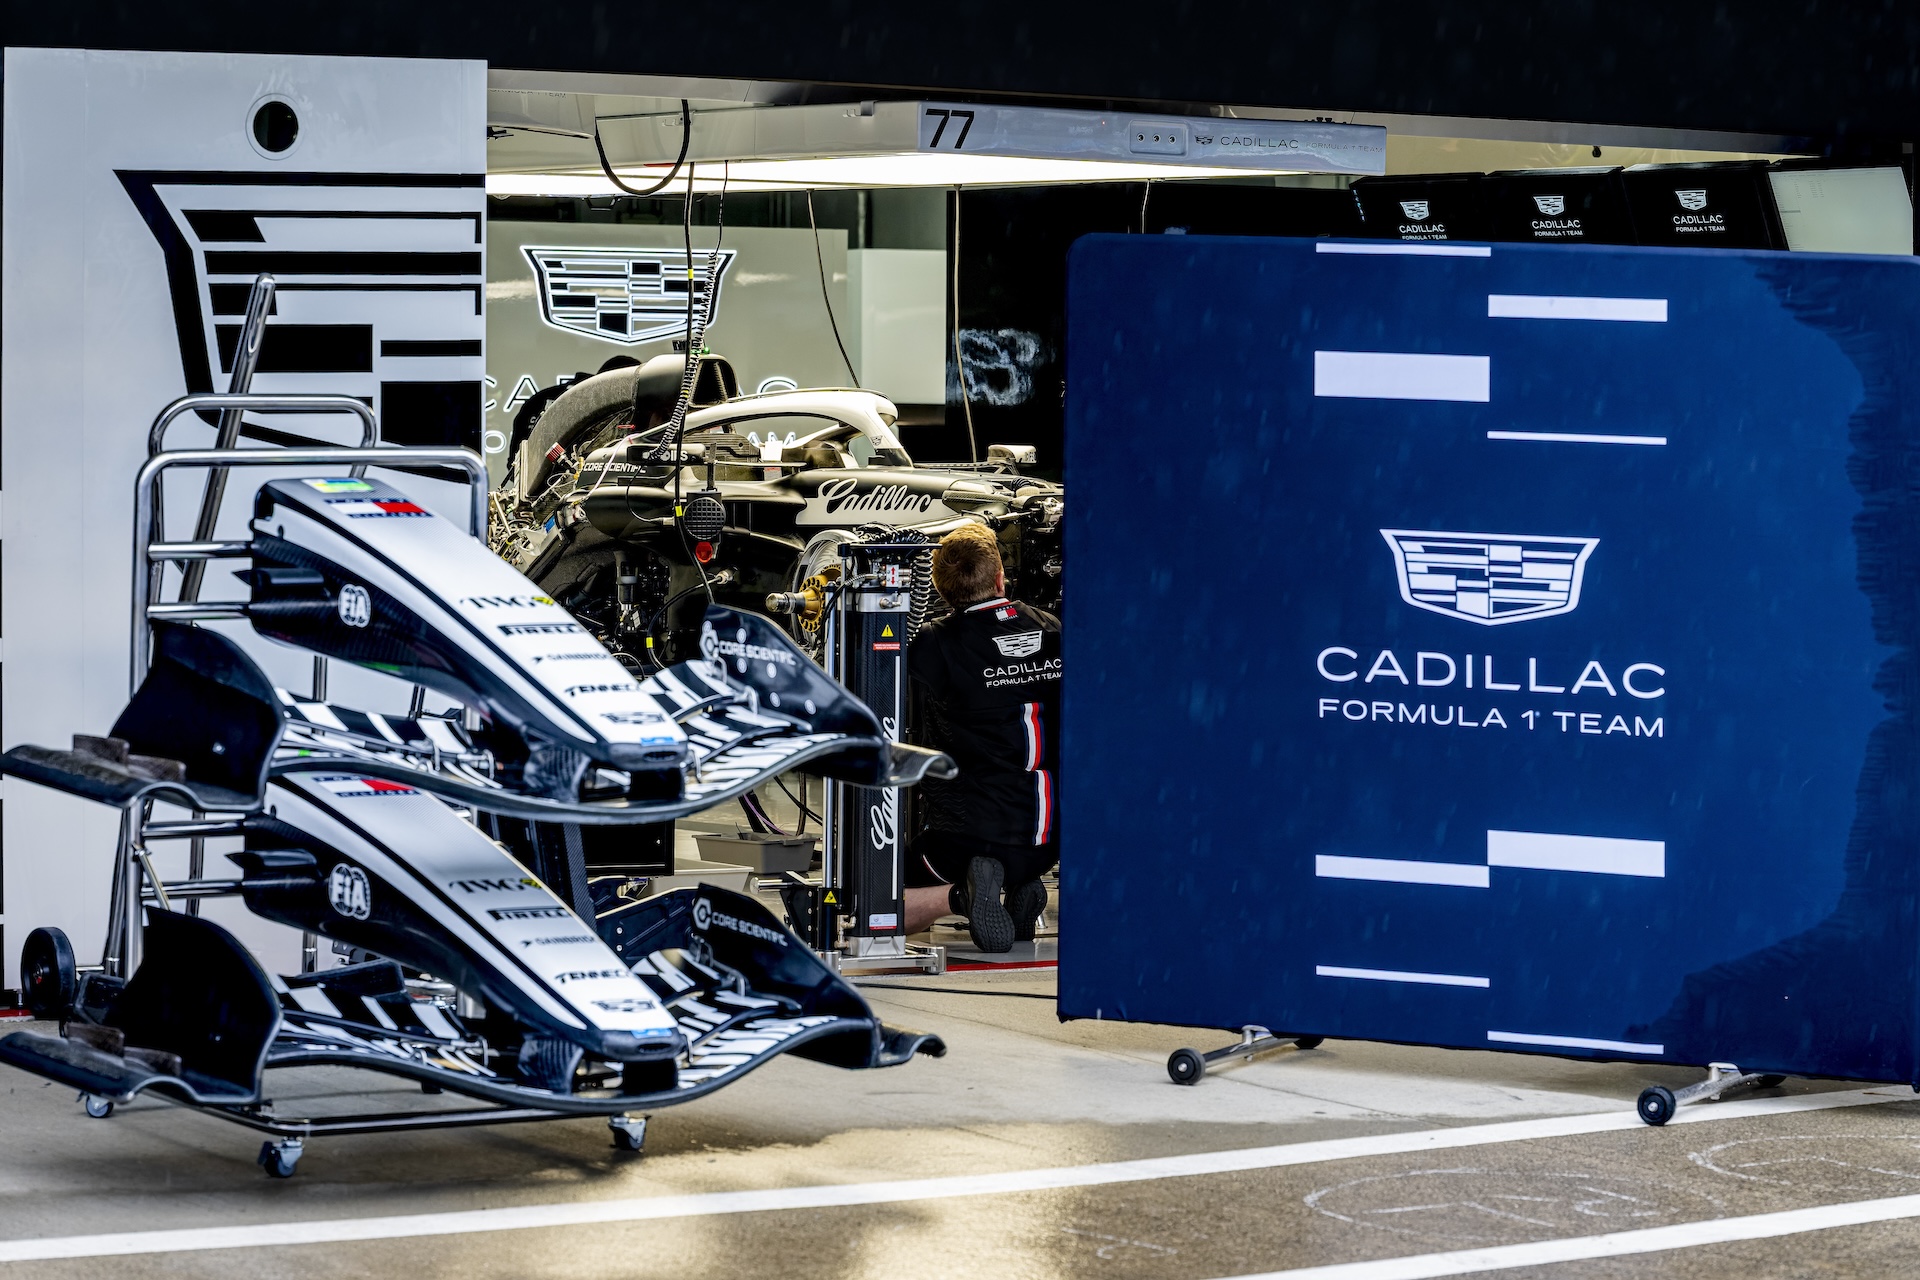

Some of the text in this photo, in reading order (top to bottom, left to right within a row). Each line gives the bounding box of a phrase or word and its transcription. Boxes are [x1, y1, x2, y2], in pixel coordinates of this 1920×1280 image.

[925, 108, 975, 149] 77
[1220, 136, 1299, 149] CADILLAC
[1305, 142, 1348, 151] FORMULA
[1358, 145, 1383, 153] TEAM
[1532, 220, 1581, 229] CADILLAC
[1673, 214, 1723, 224] CADILLAC
[1399, 224, 1445, 234] CADILLAC
[583, 462, 603, 472] CORE
[818, 478, 933, 514] Cadillac
[719, 640, 746, 658] CORE
[983, 658, 1062, 678] CADILLAC
[1316, 646, 1666, 699] CADILLAC
[986, 676, 1034, 688] FORMULA
[1319, 698, 1664, 738] FORMULA 1 TEAM
[330, 869, 368, 913] FIA
[448, 878, 525, 893] TWG
[712, 911, 738, 931] CORE
